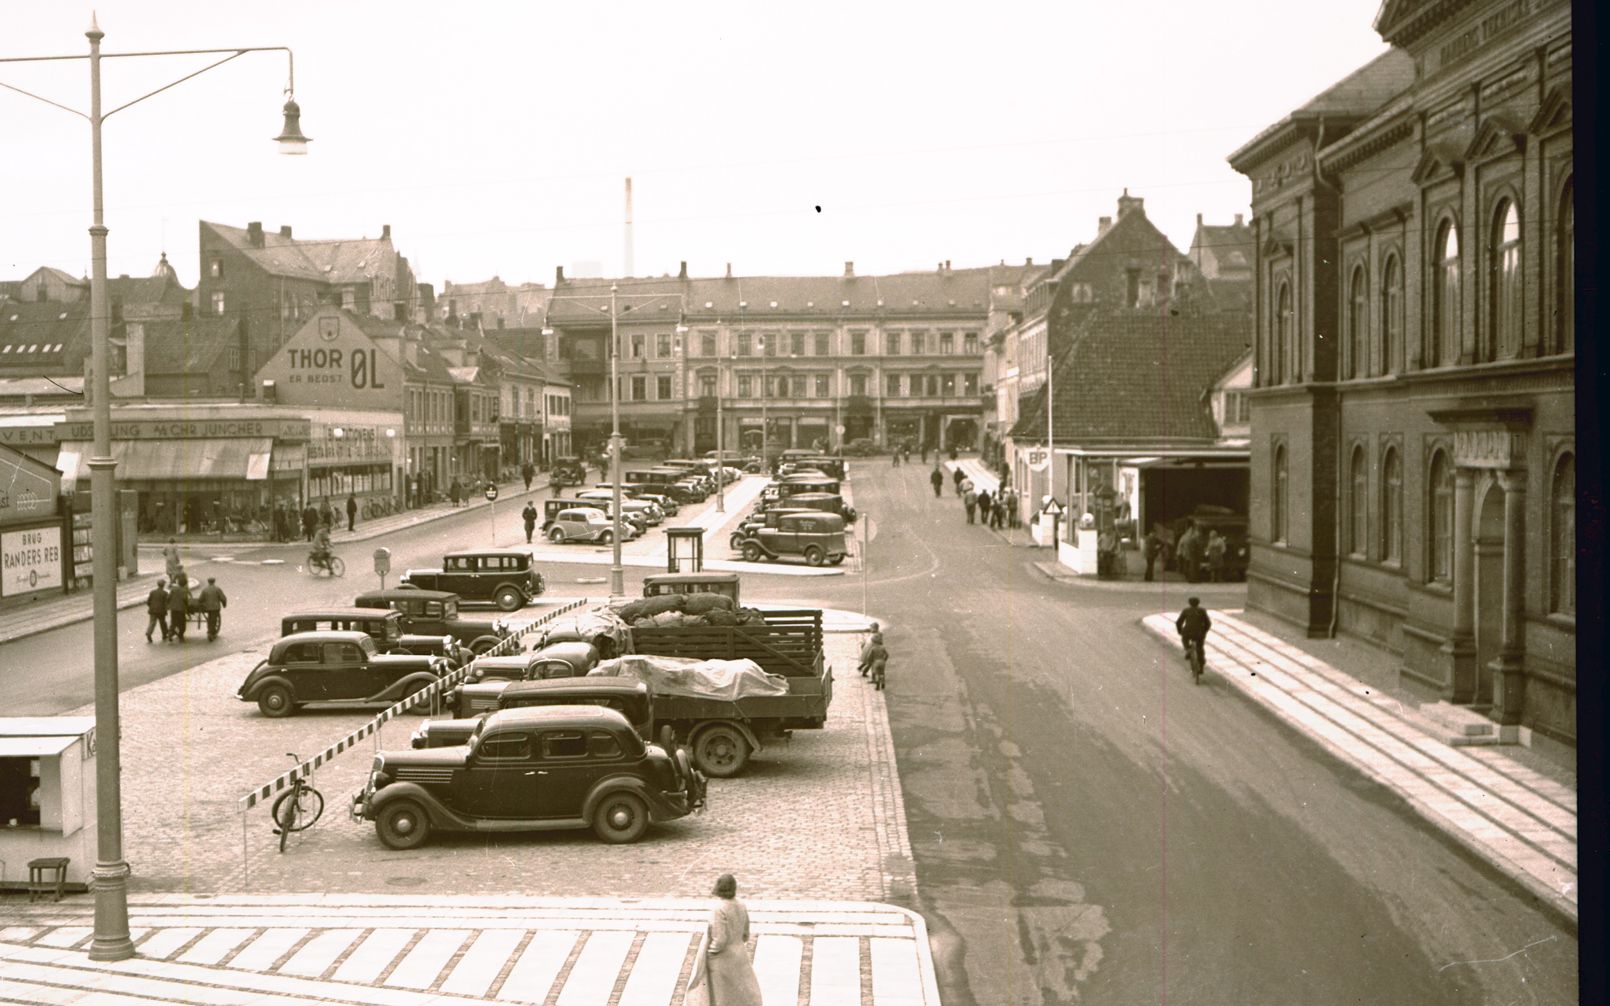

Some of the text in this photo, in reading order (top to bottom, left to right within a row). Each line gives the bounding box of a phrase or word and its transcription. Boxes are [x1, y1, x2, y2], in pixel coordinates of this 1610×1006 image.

[288, 348, 385, 390] THOR ØL
[289, 374, 343, 384] ER BEDST
[71, 424, 140, 439] UDSLING
[203, 421, 263, 437] JUNCHER
[1029, 451, 1048, 465] BP
[22, 532, 42, 546] BRUG
[4, 546, 59, 569] RANDERS REB
